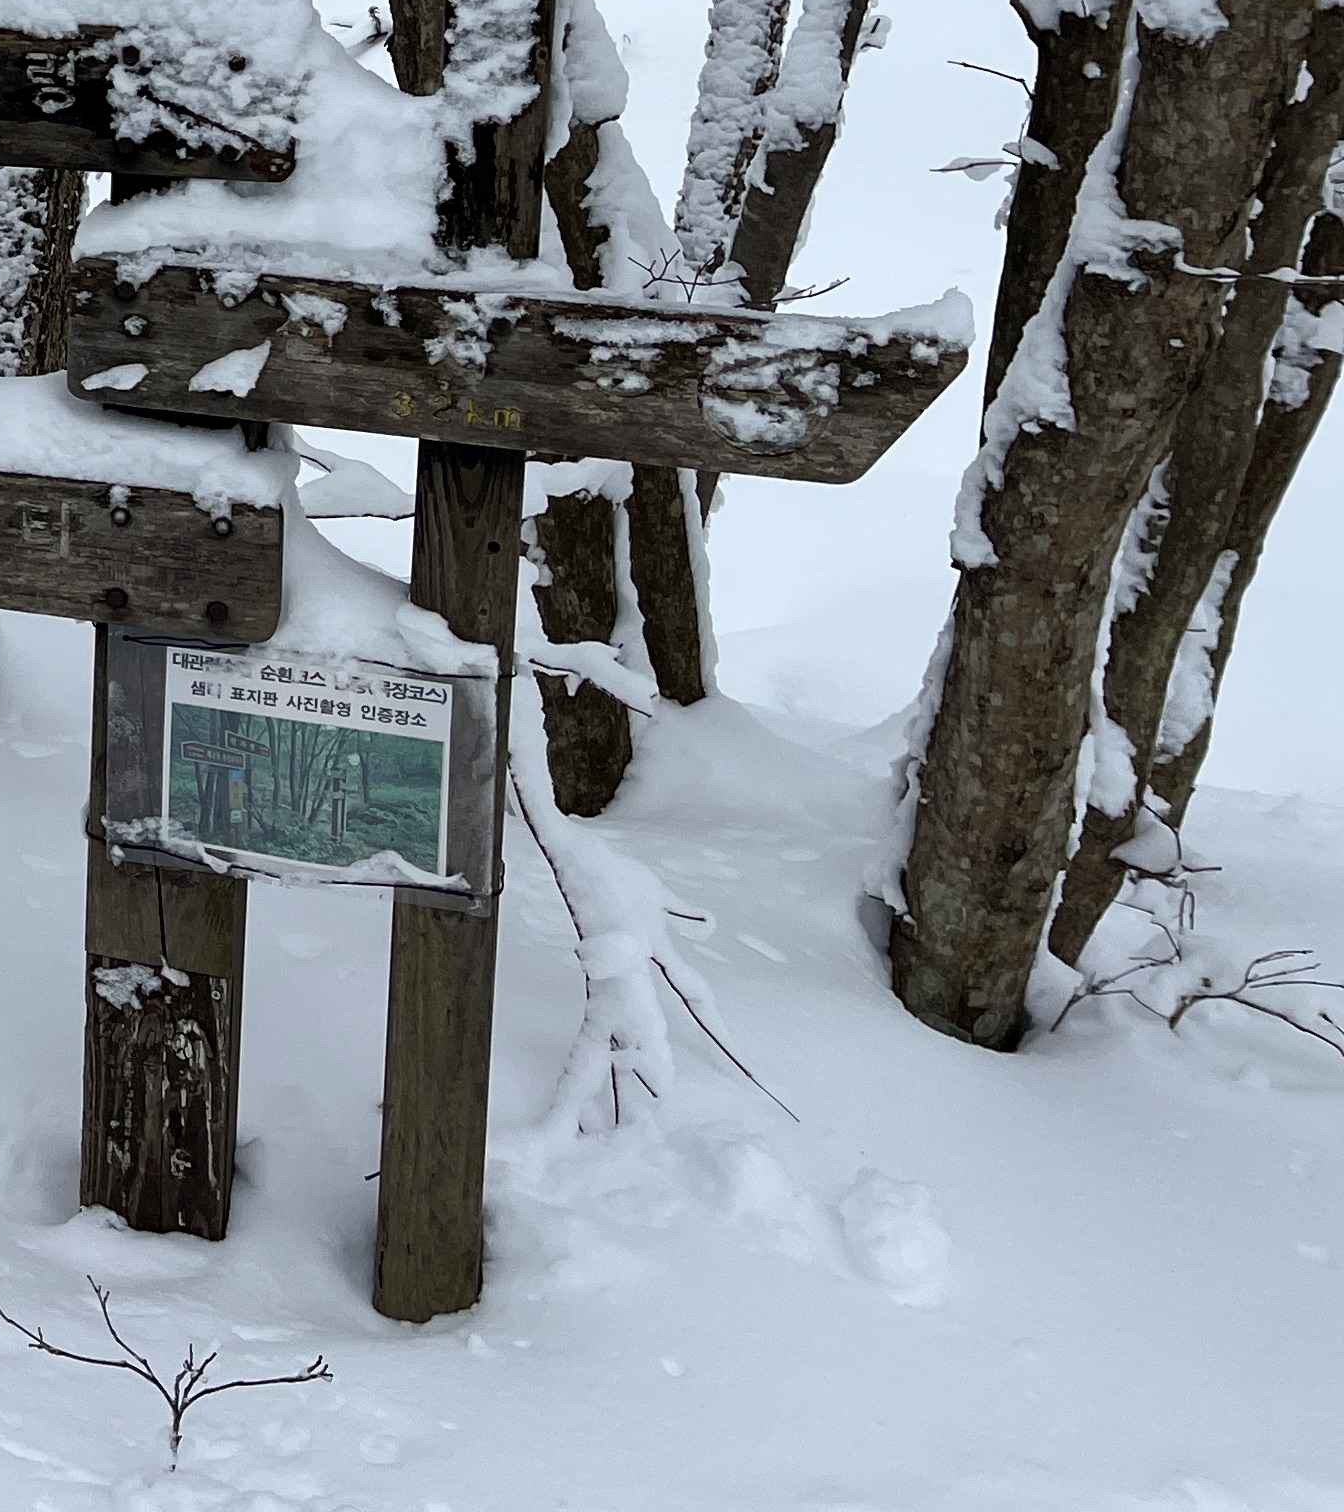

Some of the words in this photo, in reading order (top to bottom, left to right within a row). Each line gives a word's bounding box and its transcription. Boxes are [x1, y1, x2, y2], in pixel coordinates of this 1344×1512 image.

[464, 399, 524, 430] km
[230, 687, 278, 707] 표지판
[286, 695, 352, 718] 사진촬영
[360, 704, 428, 728] 인증장소
